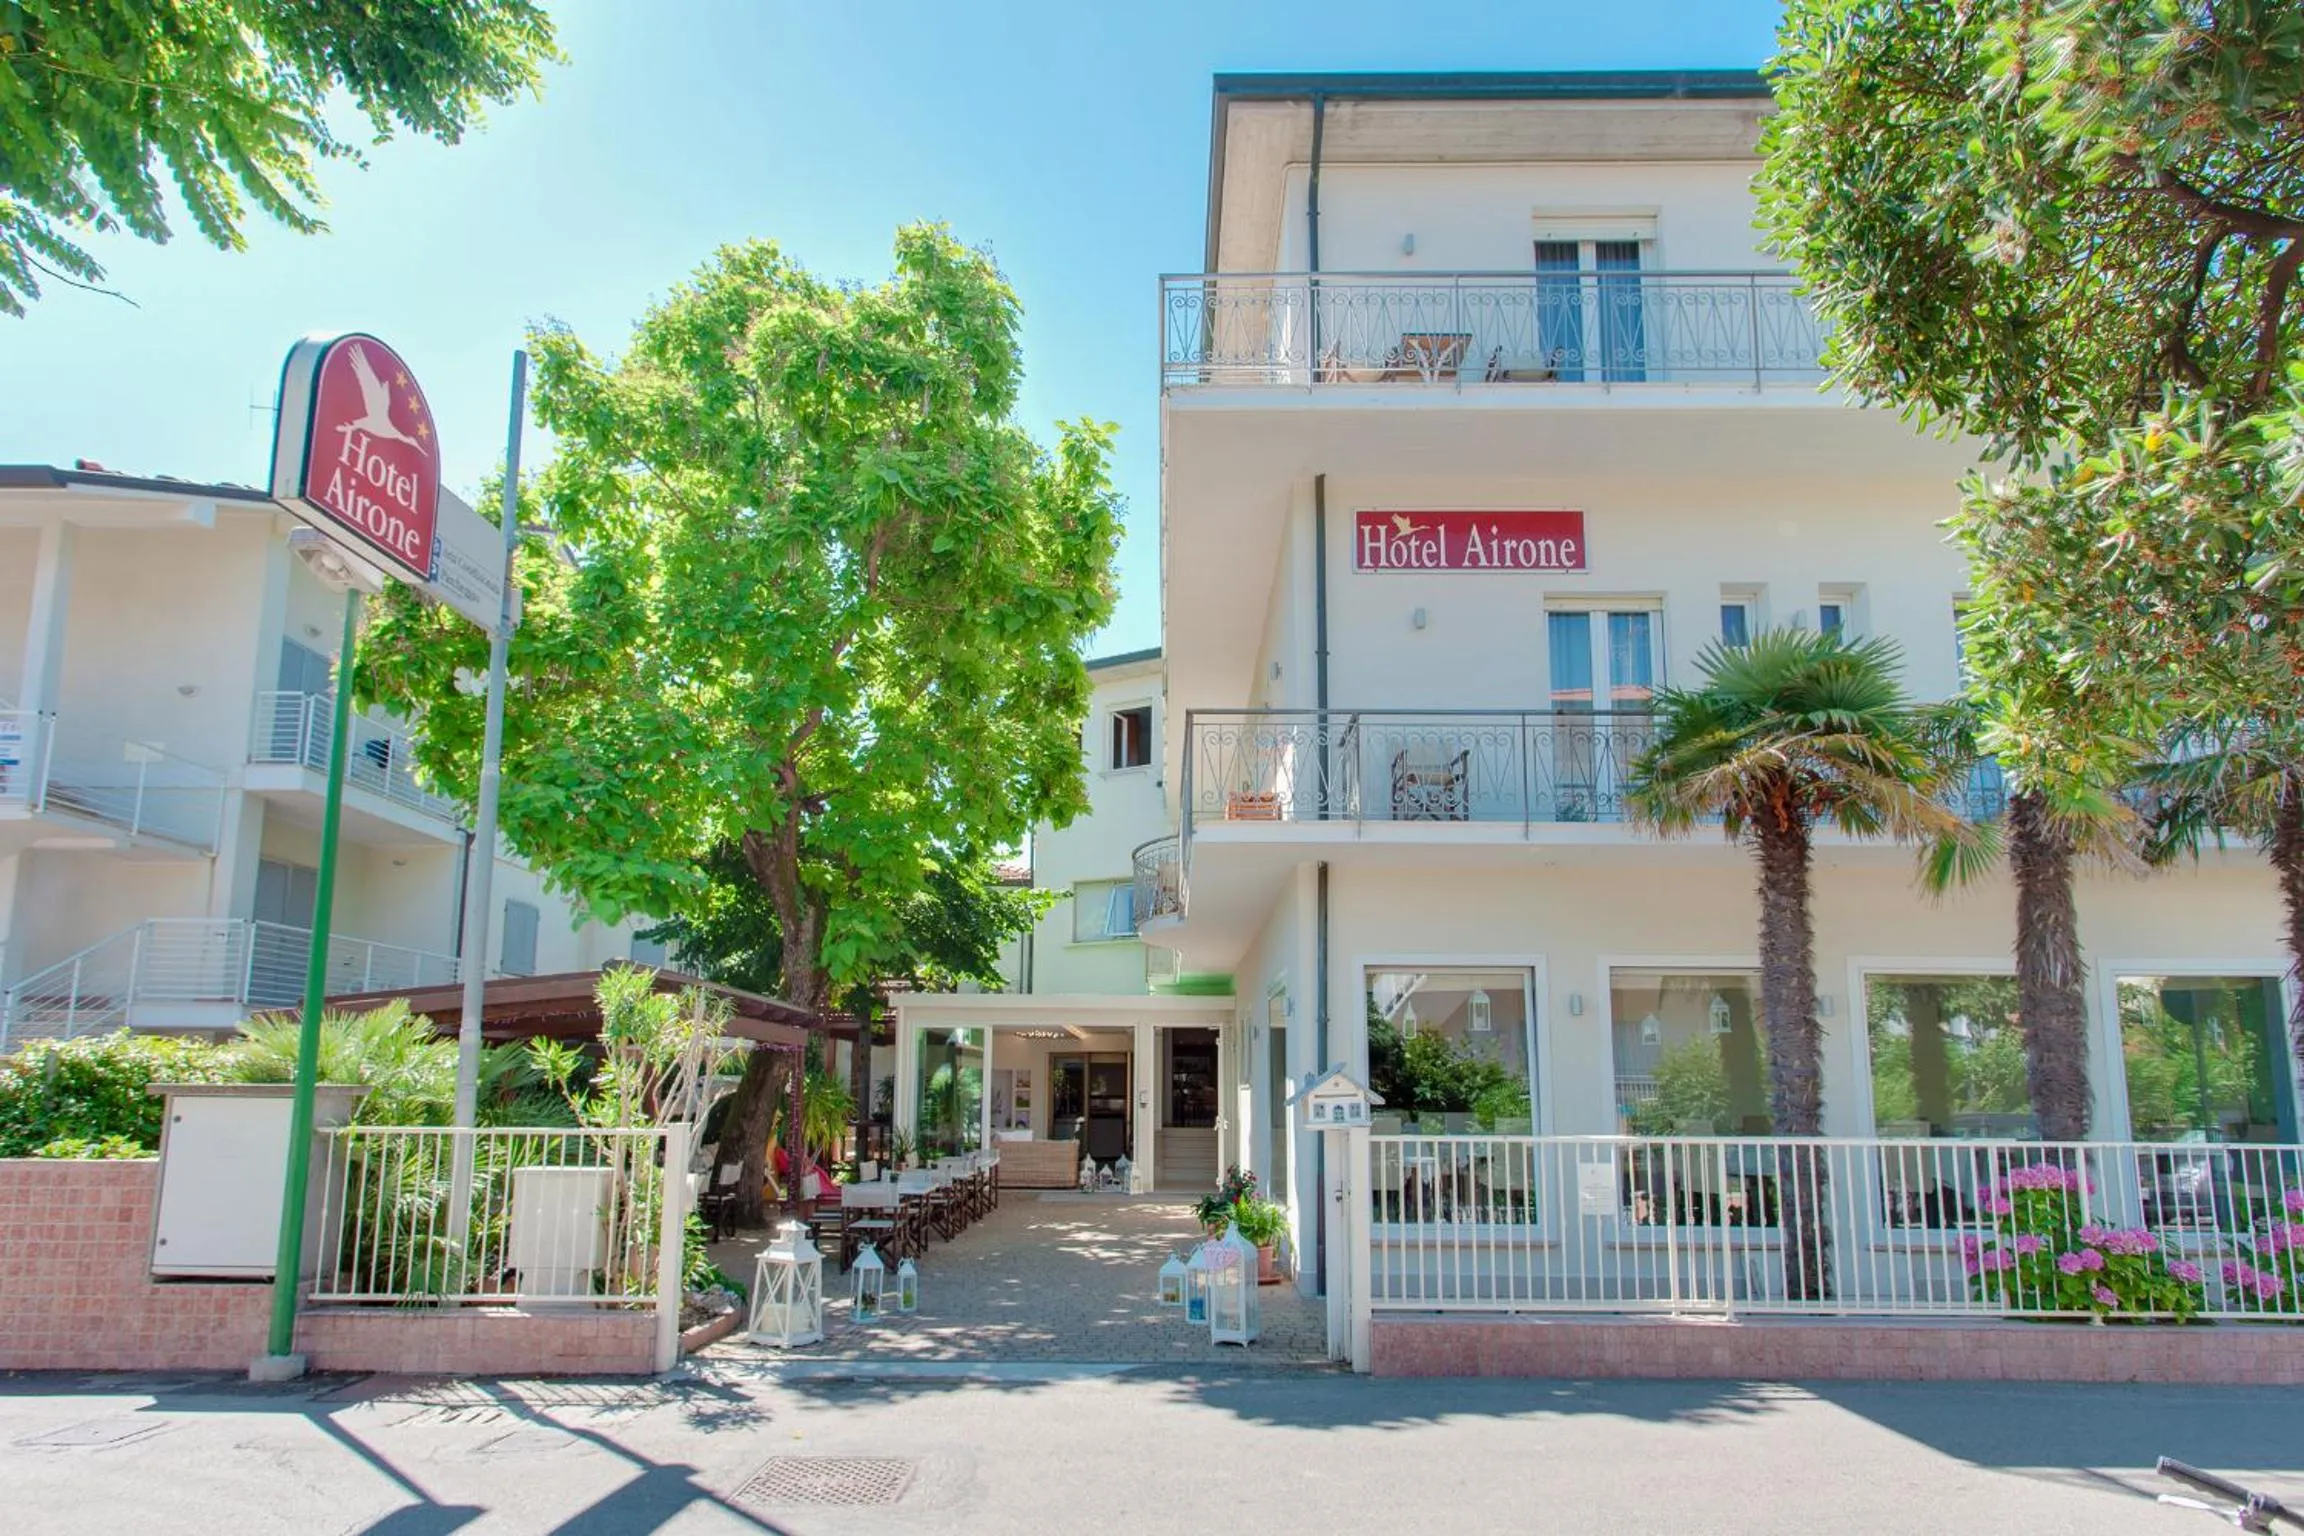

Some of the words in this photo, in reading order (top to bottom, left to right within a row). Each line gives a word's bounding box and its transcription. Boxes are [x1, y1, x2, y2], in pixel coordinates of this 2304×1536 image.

[323, 467, 420, 561] Airone
[338, 429, 419, 514] Hotel
[1360, 524, 1449, 567] Hotel
[1462, 523, 1576, 567] Airone
